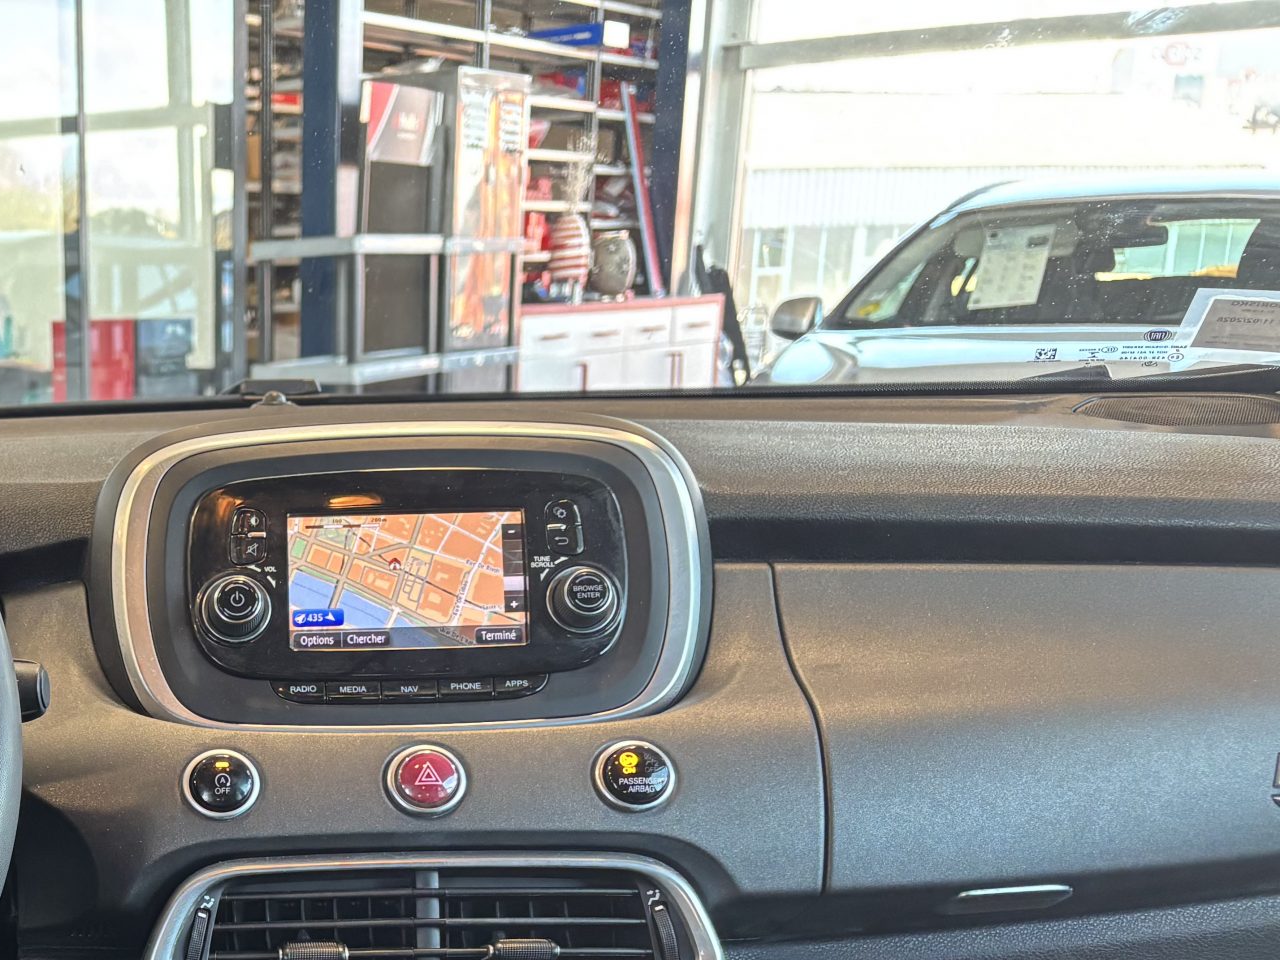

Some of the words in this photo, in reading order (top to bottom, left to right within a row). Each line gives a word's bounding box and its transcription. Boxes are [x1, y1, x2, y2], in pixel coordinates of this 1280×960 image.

[572, 584, 604, 592] BROWSE
[576, 591, 601, 599] ENTER
[307, 613, 324, 622] 435
[347, 633, 387, 645] Chercher
[480, 628, 517, 641] Terminé
[300, 634, 335, 647] Options
[450, 682, 483, 691] PHONE
[504, 680, 530, 688] APPS
[289, 685, 318, 694] RADIO
[339, 685, 368, 694] MEDIA
[400, 685, 419, 693] NAV
[622, 766, 636, 775] ON
[214, 787, 231, 795] OFF
[628, 785, 655, 793] AIRBAG
